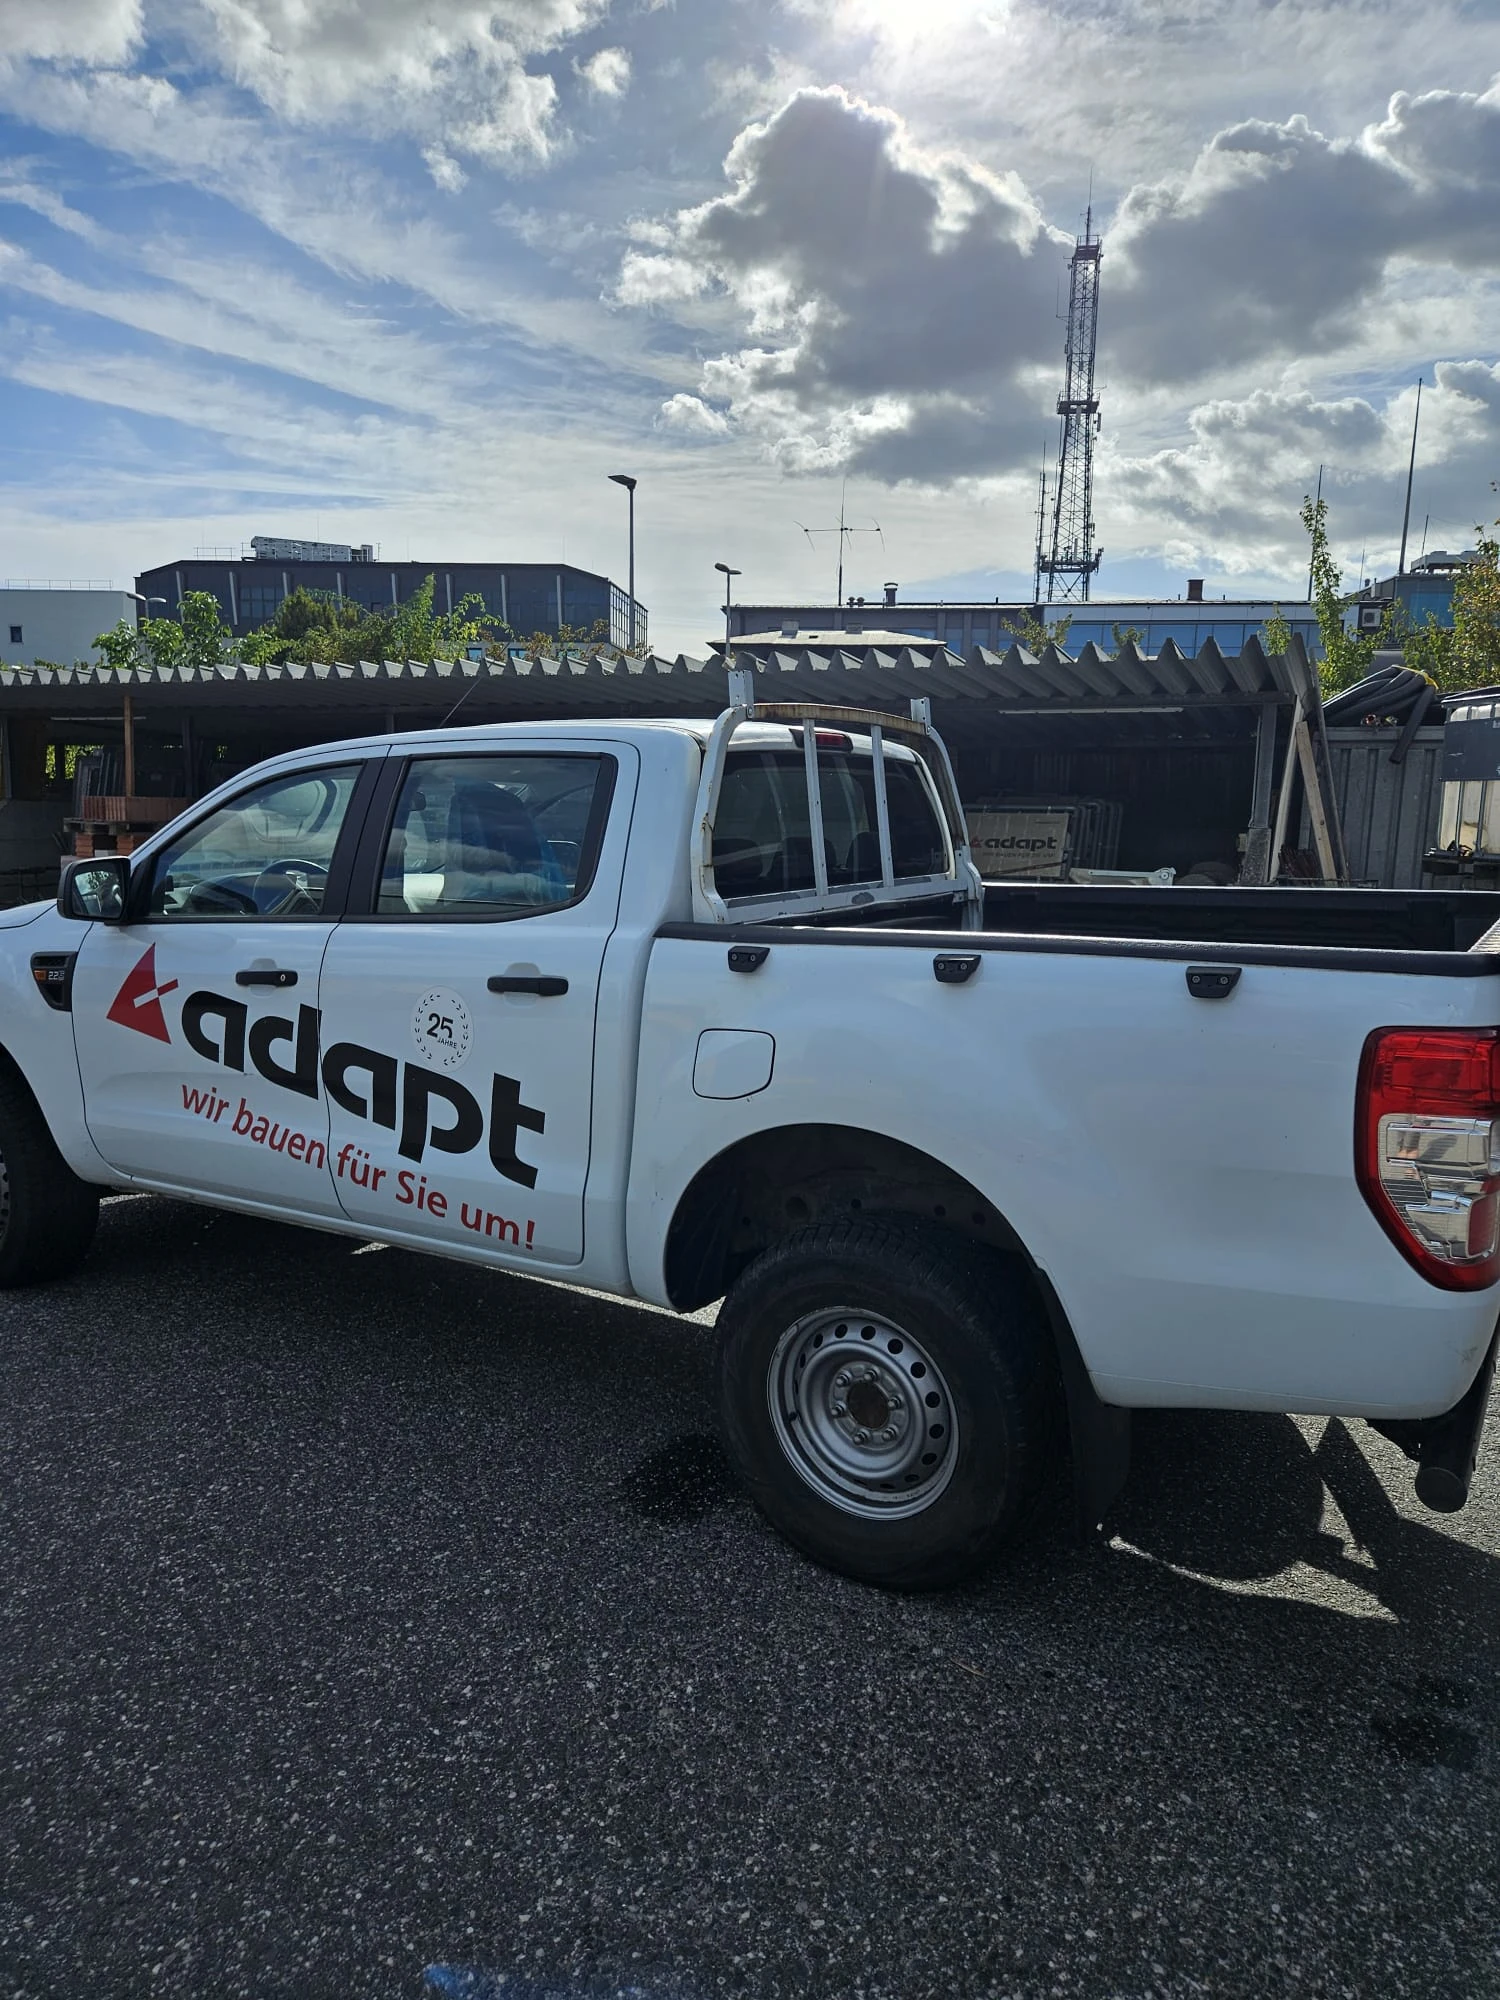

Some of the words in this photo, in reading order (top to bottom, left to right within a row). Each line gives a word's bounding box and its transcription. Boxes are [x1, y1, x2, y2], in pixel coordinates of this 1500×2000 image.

[985, 836, 1058, 851] adapt
[426, 1012, 454, 1039] 25
[437, 1037, 458, 1050] JAHRE
[181, 990, 546, 1189] adapt
[181, 1084, 230, 1123] wir
[231, 1097, 326, 1169] bauen
[337, 1143, 387, 1192] für
[395, 1170, 448, 1218] Sie
[460, 1202, 536, 1250] um!
